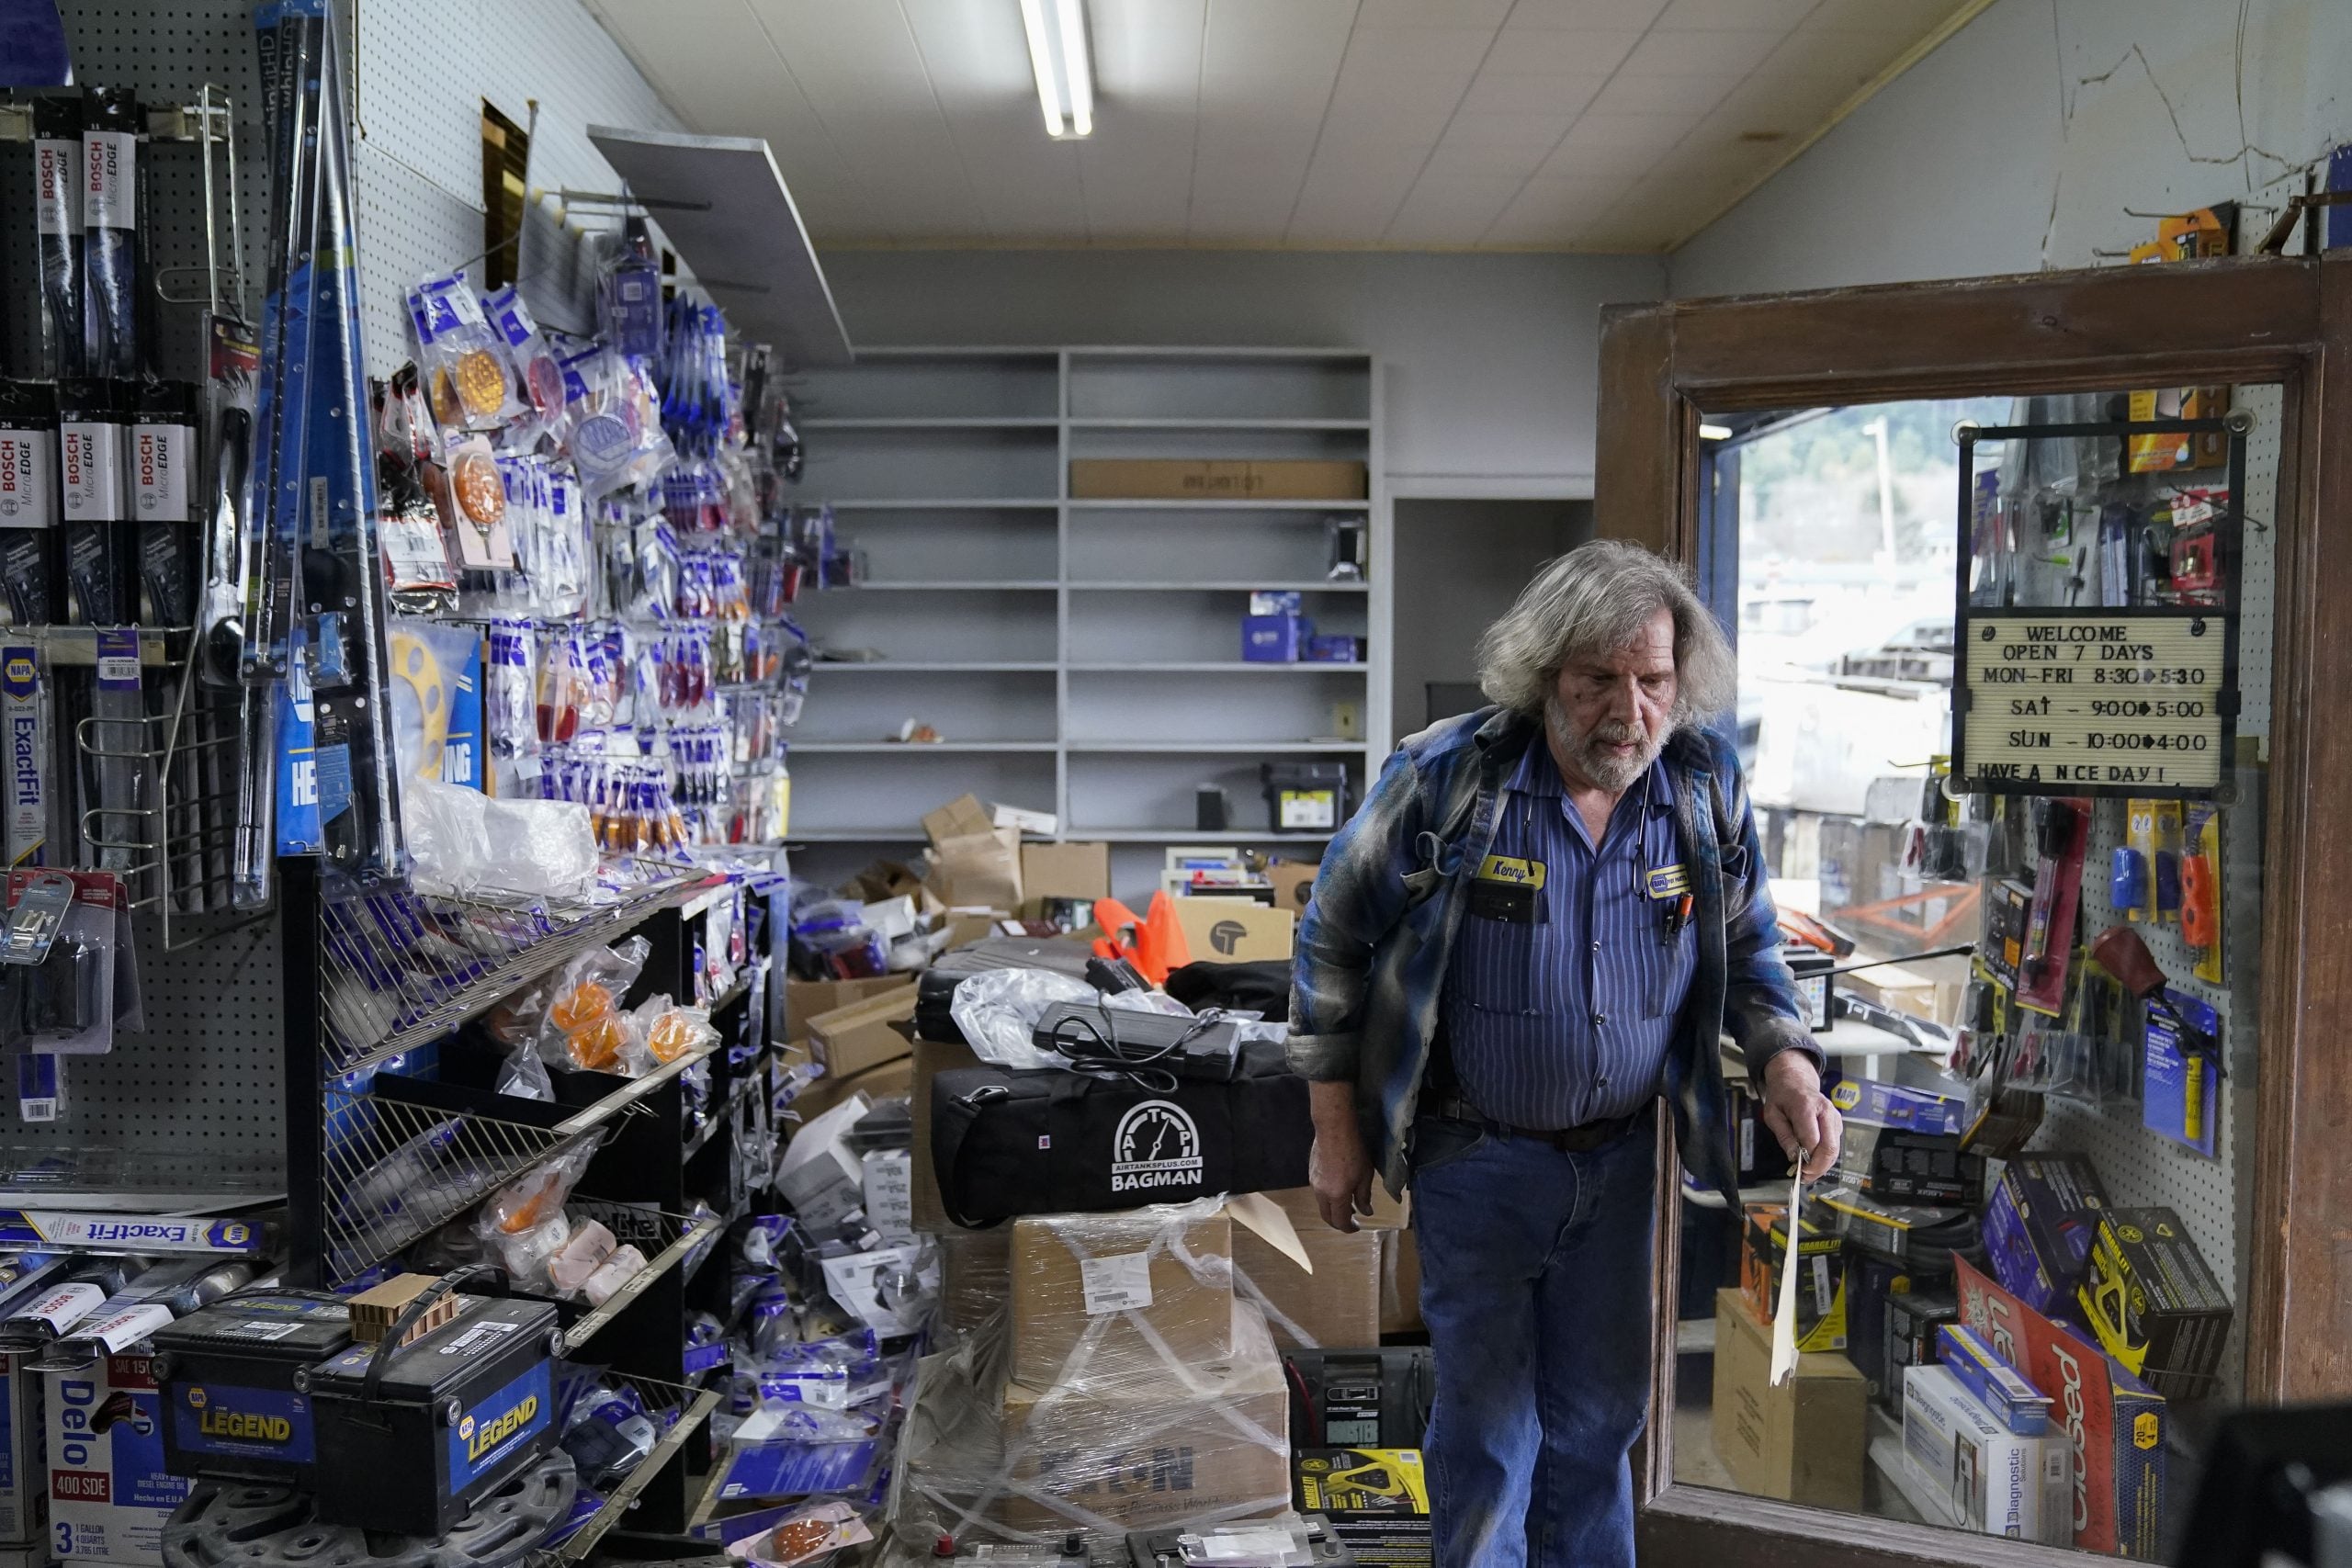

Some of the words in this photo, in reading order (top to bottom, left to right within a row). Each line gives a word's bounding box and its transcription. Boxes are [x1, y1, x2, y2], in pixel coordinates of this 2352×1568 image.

[41, 149, 54, 199] BOSCH
[91, 141, 103, 192] BOSCH
[1, 441, 16, 491] BOSCH
[67, 434, 80, 484] BOSCH
[83, 434, 96, 499] MicroEDGE
[141, 434, 153, 486] BOSCH
[157, 435, 170, 500] MicroEDGE
[19, 442, 33, 506] MicroEDGE
[2026, 626, 2127, 642] WELCOME
[2003, 645, 2057, 661] OPEN
[2075, 645, 2085, 661] 7
[2101, 645, 2154, 660] DAYS
[10, 664, 31, 676] NAPA
[2094, 668, 2140, 684] 8:30
[2160, 668, 2205, 684] 5:30
[2091, 700, 2137, 716] 9:00
[2156, 701, 2204, 717] 5:00
[2008, 729, 2051, 748] SUN
[2086, 732, 2141, 750] 10:00
[2156, 734, 2207, 750] 4:00
[14, 716, 40, 807] ExactFit
[1977, 763, 2021, 779] HAVE
[2029, 764, 2041, 781] A
[1493, 861, 1526, 882] Kenny
[1835, 1088, 1856, 1102] NAPA
[1115, 1159, 1198, 1172] AIRTANKSPLUS.COM
[1112, 1169, 1203, 1191] BAGMAN
[87, 1224, 187, 1242] ExactFit
[115, 1359, 130, 1374] SAE
[61, 1380, 96, 1465] Delo
[201, 1410, 290, 1441] LEGEND
[469, 1394, 537, 1462] LEGEND
[2136, 1431, 2145, 1443] 20
[2018, 1448, 2028, 1483] Solutions
[57, 1475, 80, 1495] 400
[82, 1478, 107, 1496] SDE
[2006, 1448, 2021, 1523] Diagnostic
[133, 1494, 155, 1503] Hecho
[56, 1522, 73, 1553] 3
[80, 1525, 104, 1534] GALLON
[80, 1535, 105, 1545] QUARTS
[93, 1546, 110, 1555] LITRE
